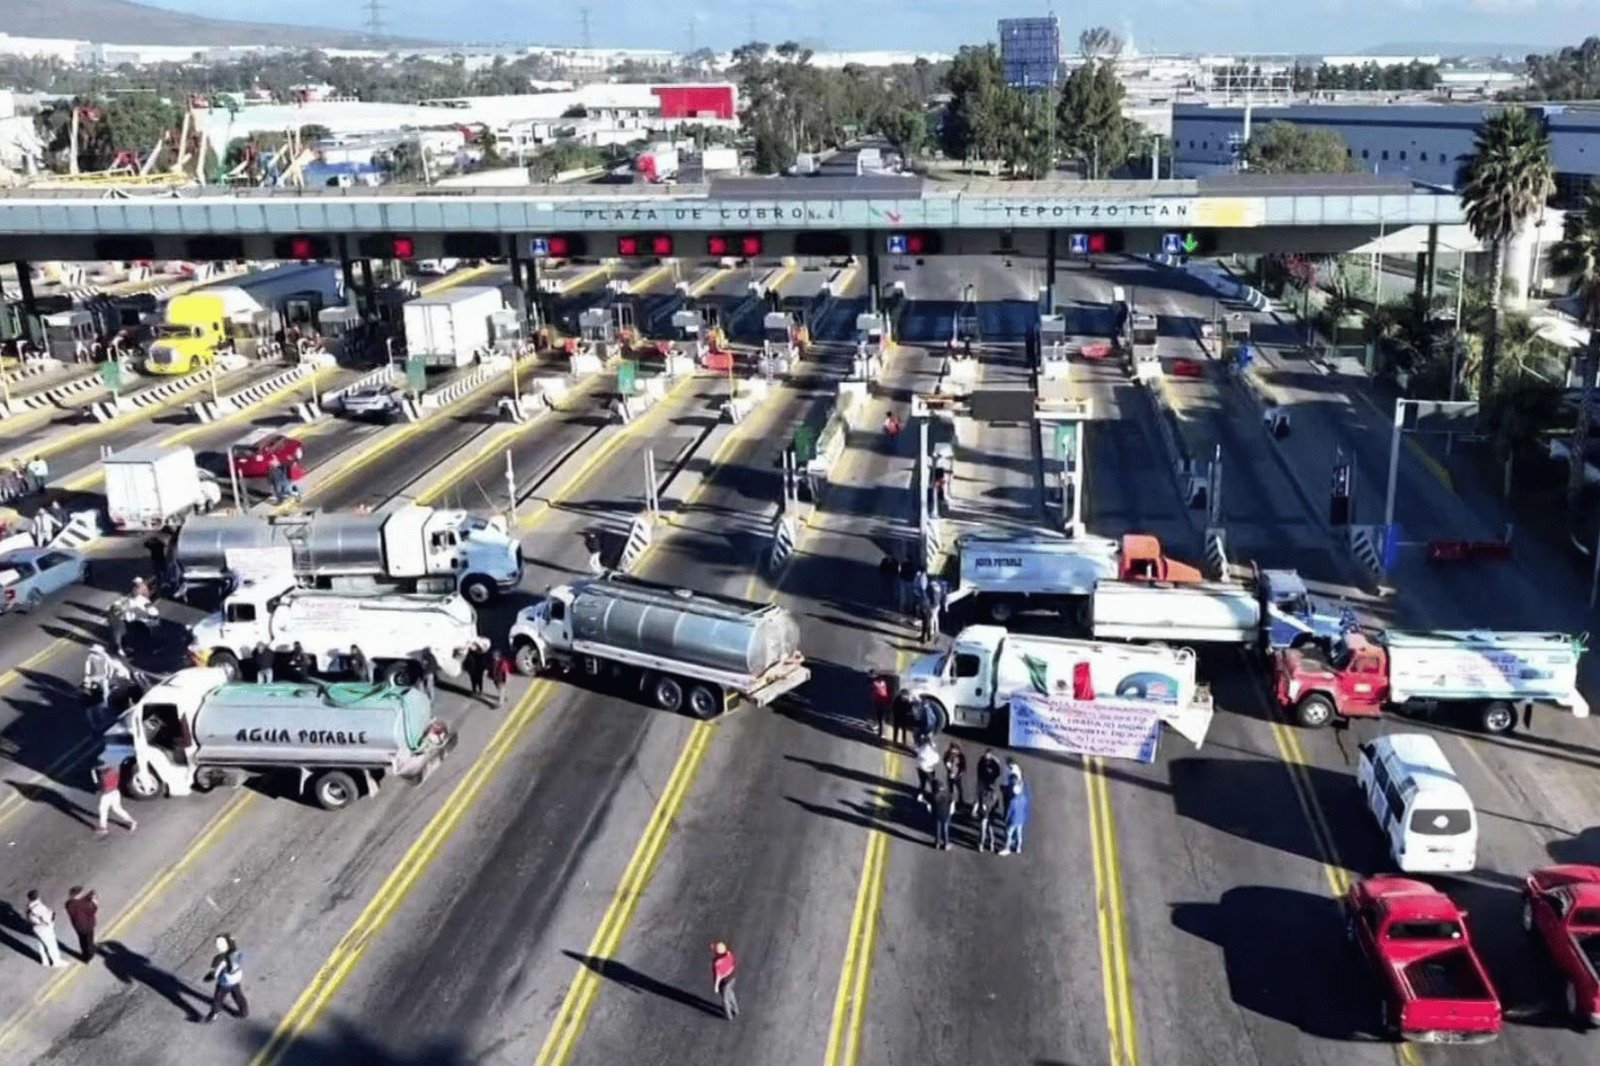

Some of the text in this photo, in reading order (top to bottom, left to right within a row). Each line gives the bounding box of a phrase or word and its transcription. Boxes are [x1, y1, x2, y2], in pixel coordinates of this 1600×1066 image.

[584, 208, 658, 220] PLAZA
[675, 208, 702, 220] DE
[720, 207, 802, 220] COBRO
[1004, 205, 1188, 218] TEPOTZOTLAN
[236, 728, 368, 745] AGUA POTABLE
